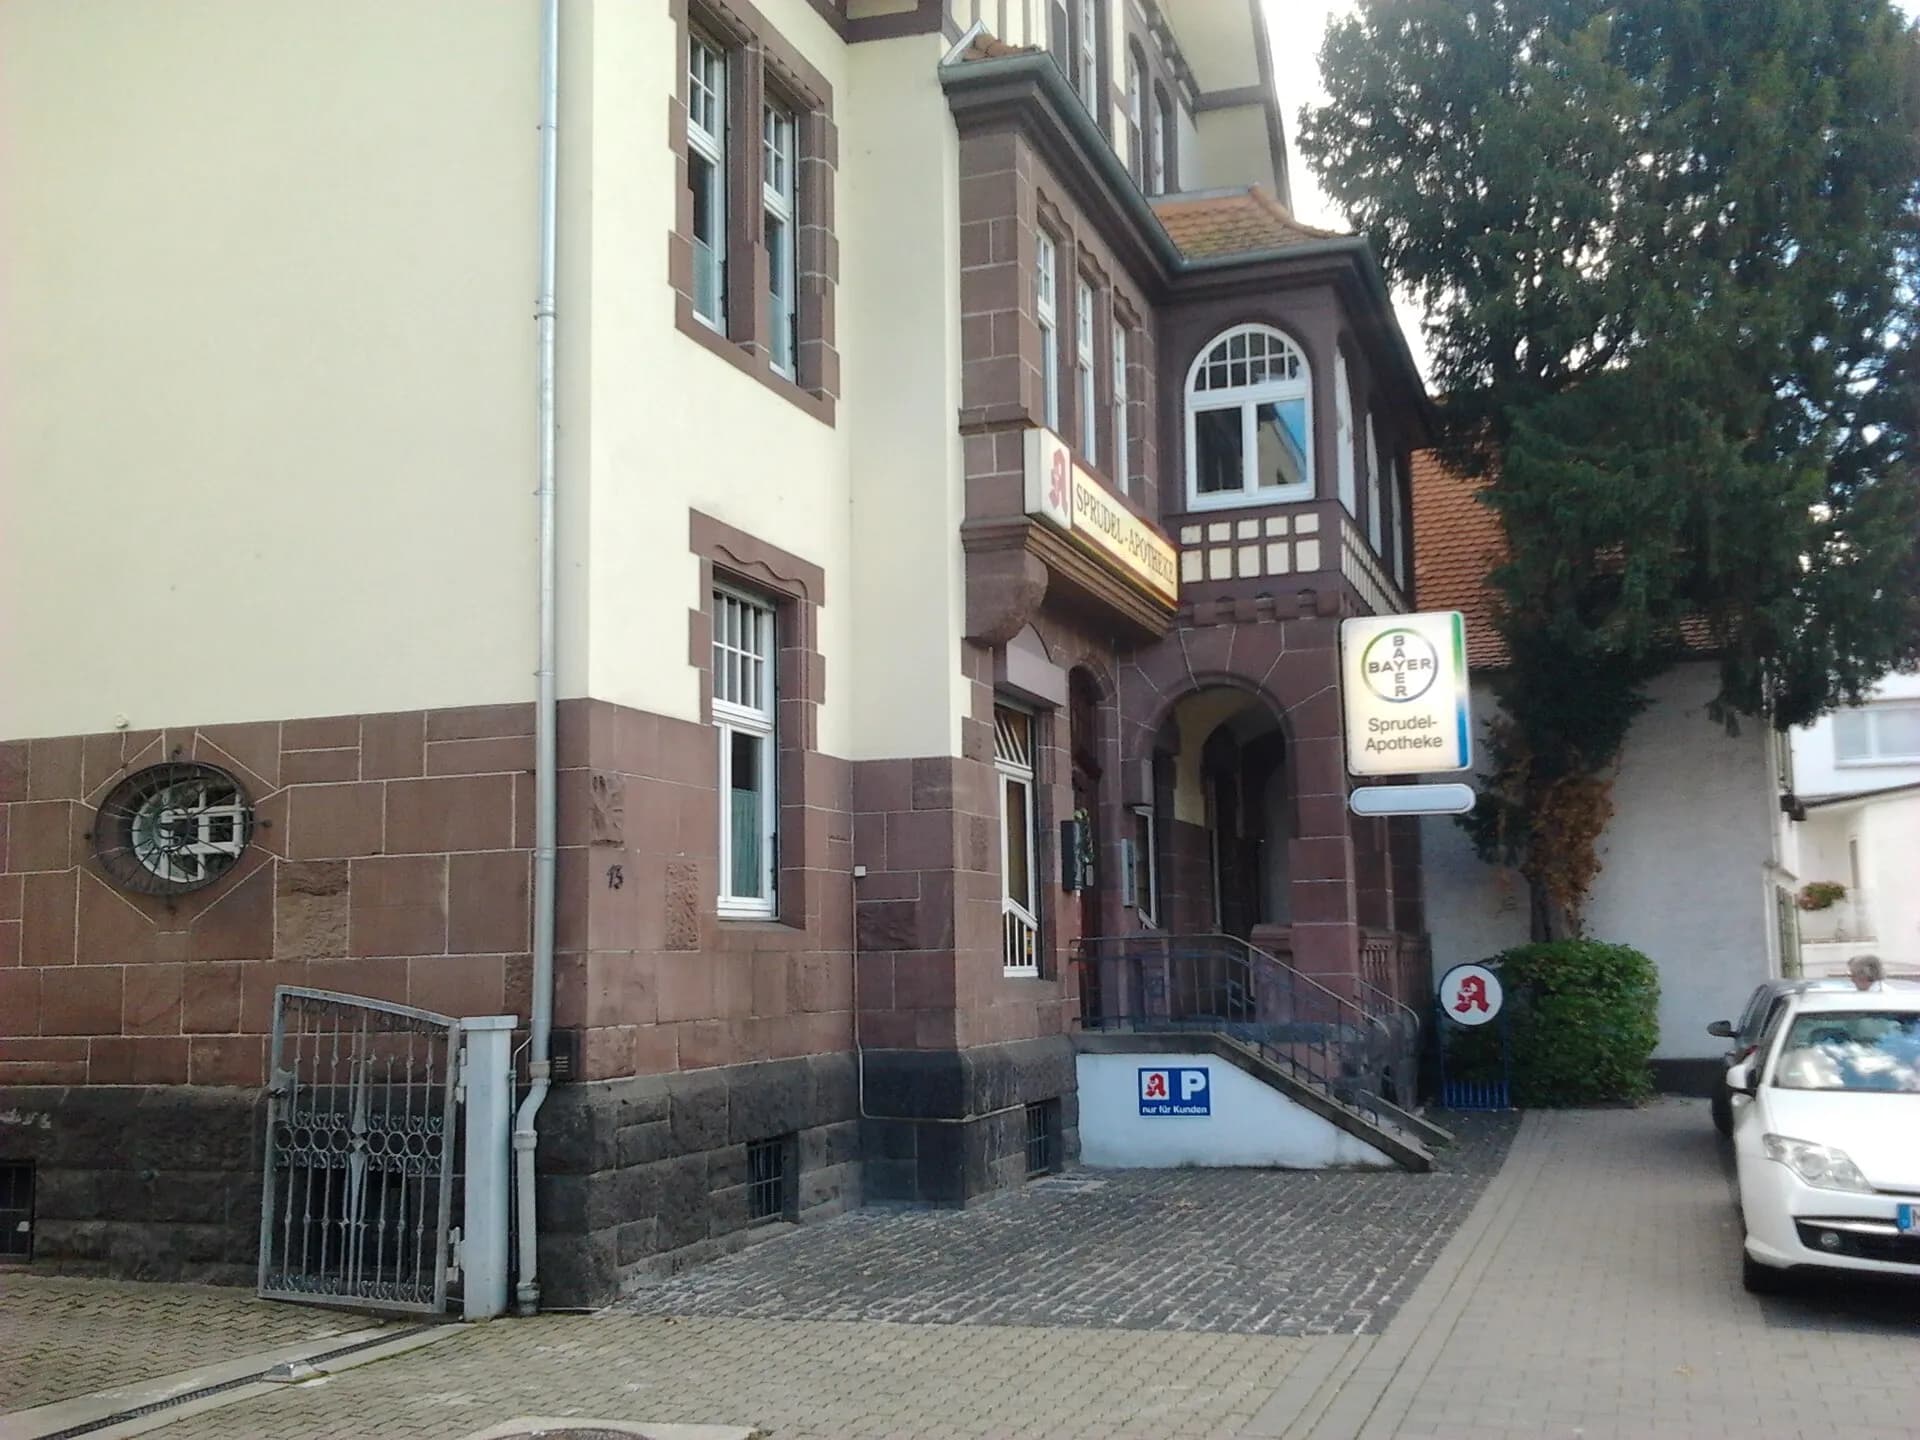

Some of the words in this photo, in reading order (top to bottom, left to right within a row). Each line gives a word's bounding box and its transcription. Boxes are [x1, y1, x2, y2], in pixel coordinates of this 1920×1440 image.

[1368, 658, 1432, 673] BAYER
[1392, 635, 1408, 697] BAYER
[1368, 715, 1437, 735] Sprudel-
[1365, 735, 1443, 754] Apotheke
[1181, 1071, 1206, 1100] P
[1142, 1105, 1157, 1113] nur
[1159, 1104, 1171, 1113] für
[1173, 1104, 1207, 1114] Kunden
